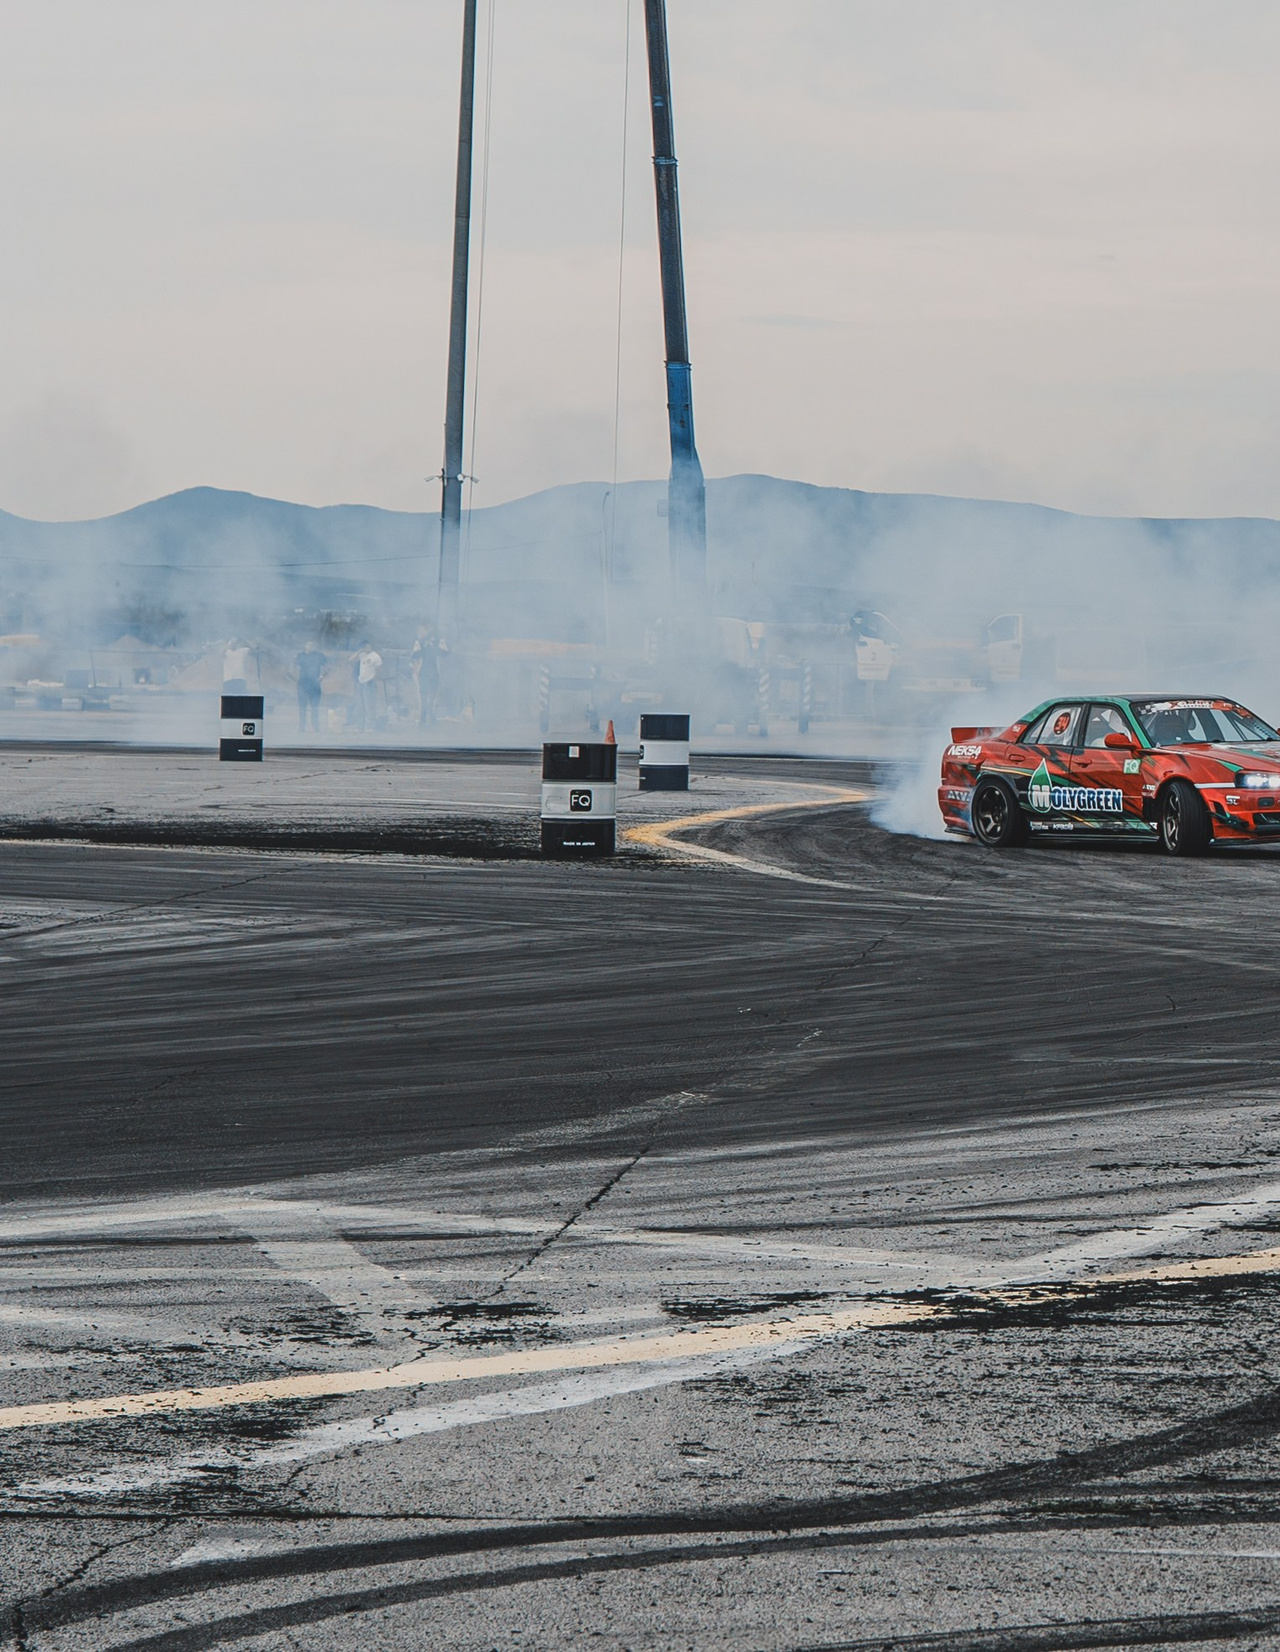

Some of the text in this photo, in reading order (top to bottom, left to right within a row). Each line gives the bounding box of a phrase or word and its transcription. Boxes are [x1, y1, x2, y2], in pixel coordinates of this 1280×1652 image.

[1055, 715, 1070, 731] 34
[1124, 760, 1139, 774] FQ
[571, 795, 591, 806] FQ
[1031, 784, 1123, 812] MOLYGREEN
